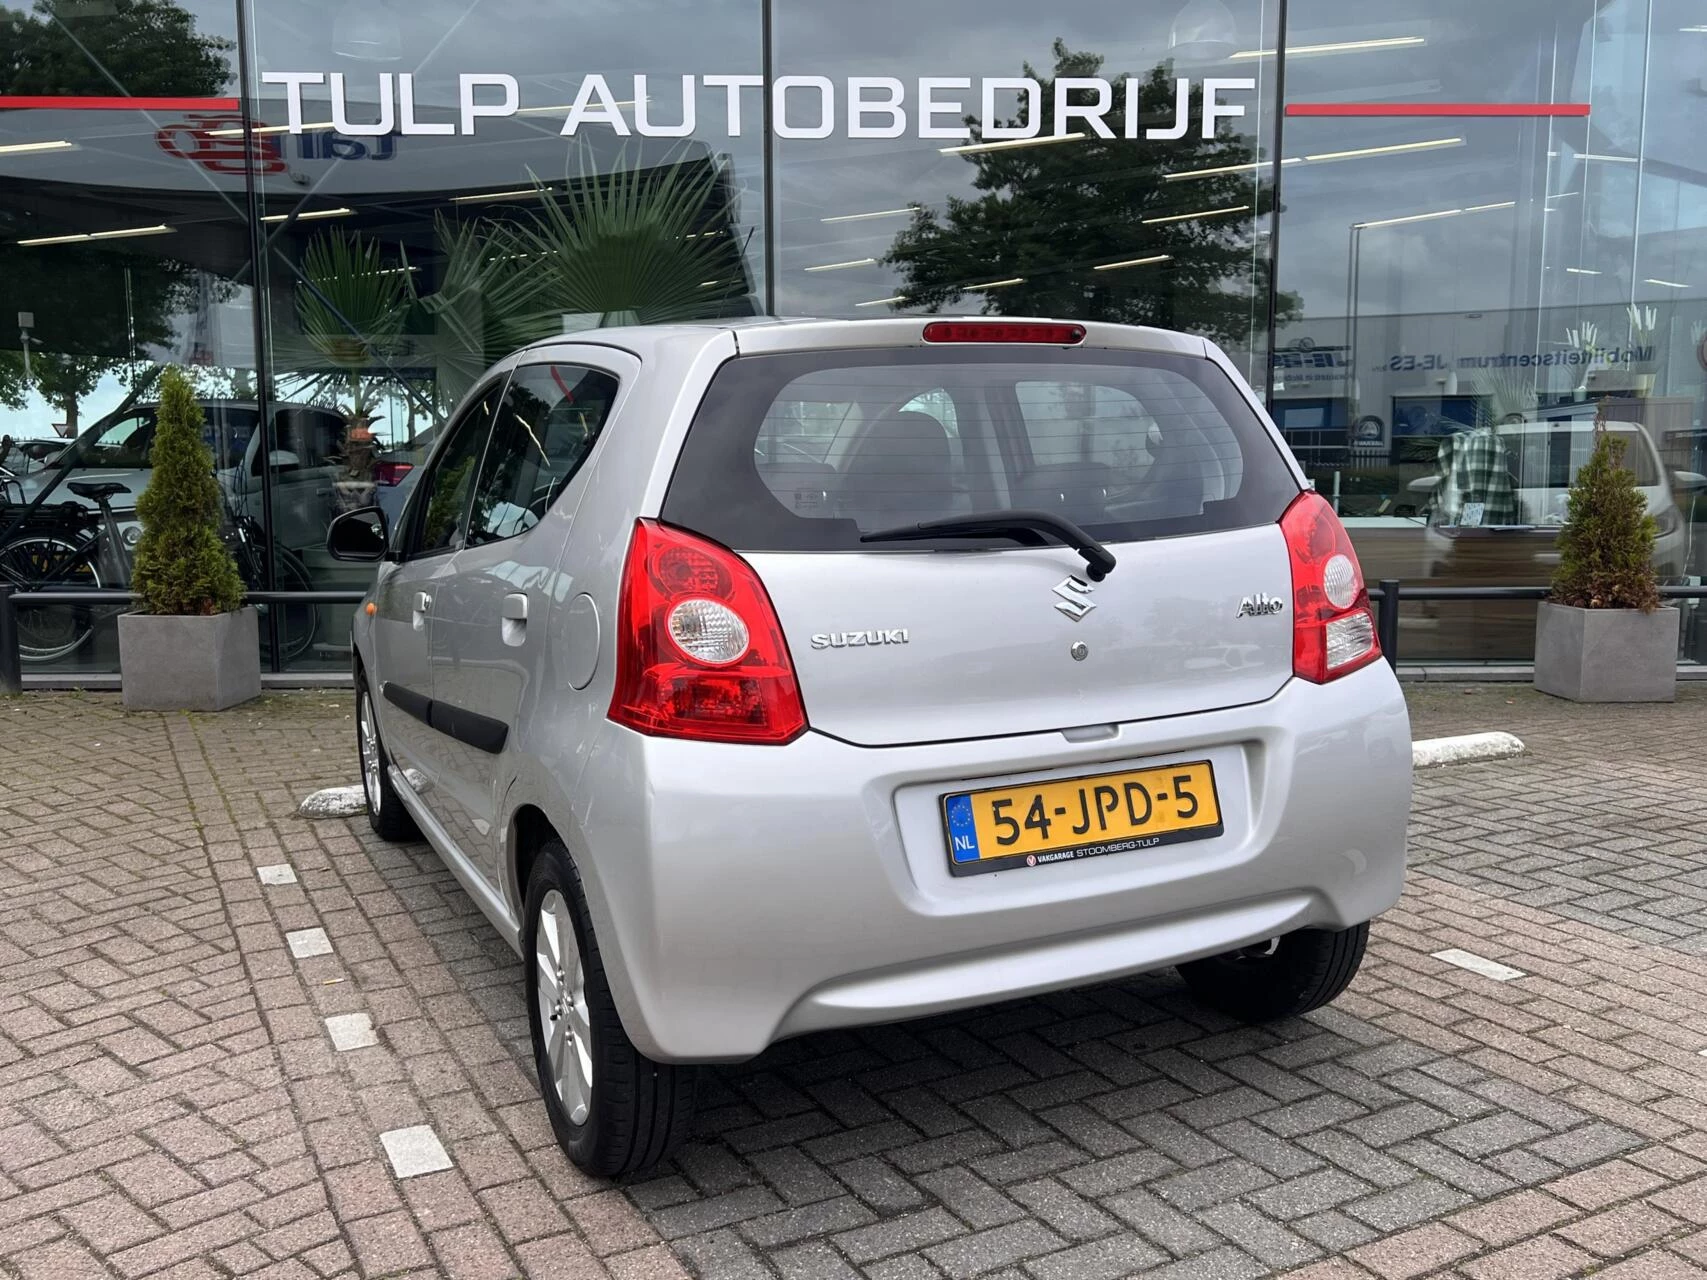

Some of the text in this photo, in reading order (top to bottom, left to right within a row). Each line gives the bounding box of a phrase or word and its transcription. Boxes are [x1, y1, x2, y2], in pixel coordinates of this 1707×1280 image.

[261, 71, 1256, 140] TULP AUTOBEDRIJF
[1236, 592, 1284, 618] Alto
[811, 628, 909, 650] SUZUKI
[991, 775, 1199, 846] 54-JPD-5
[954, 835, 975, 850] NL
[1037, 850, 1075, 863] VAKGARAGE
[1076, 837, 1160, 858] STOOMBERG-TULP
